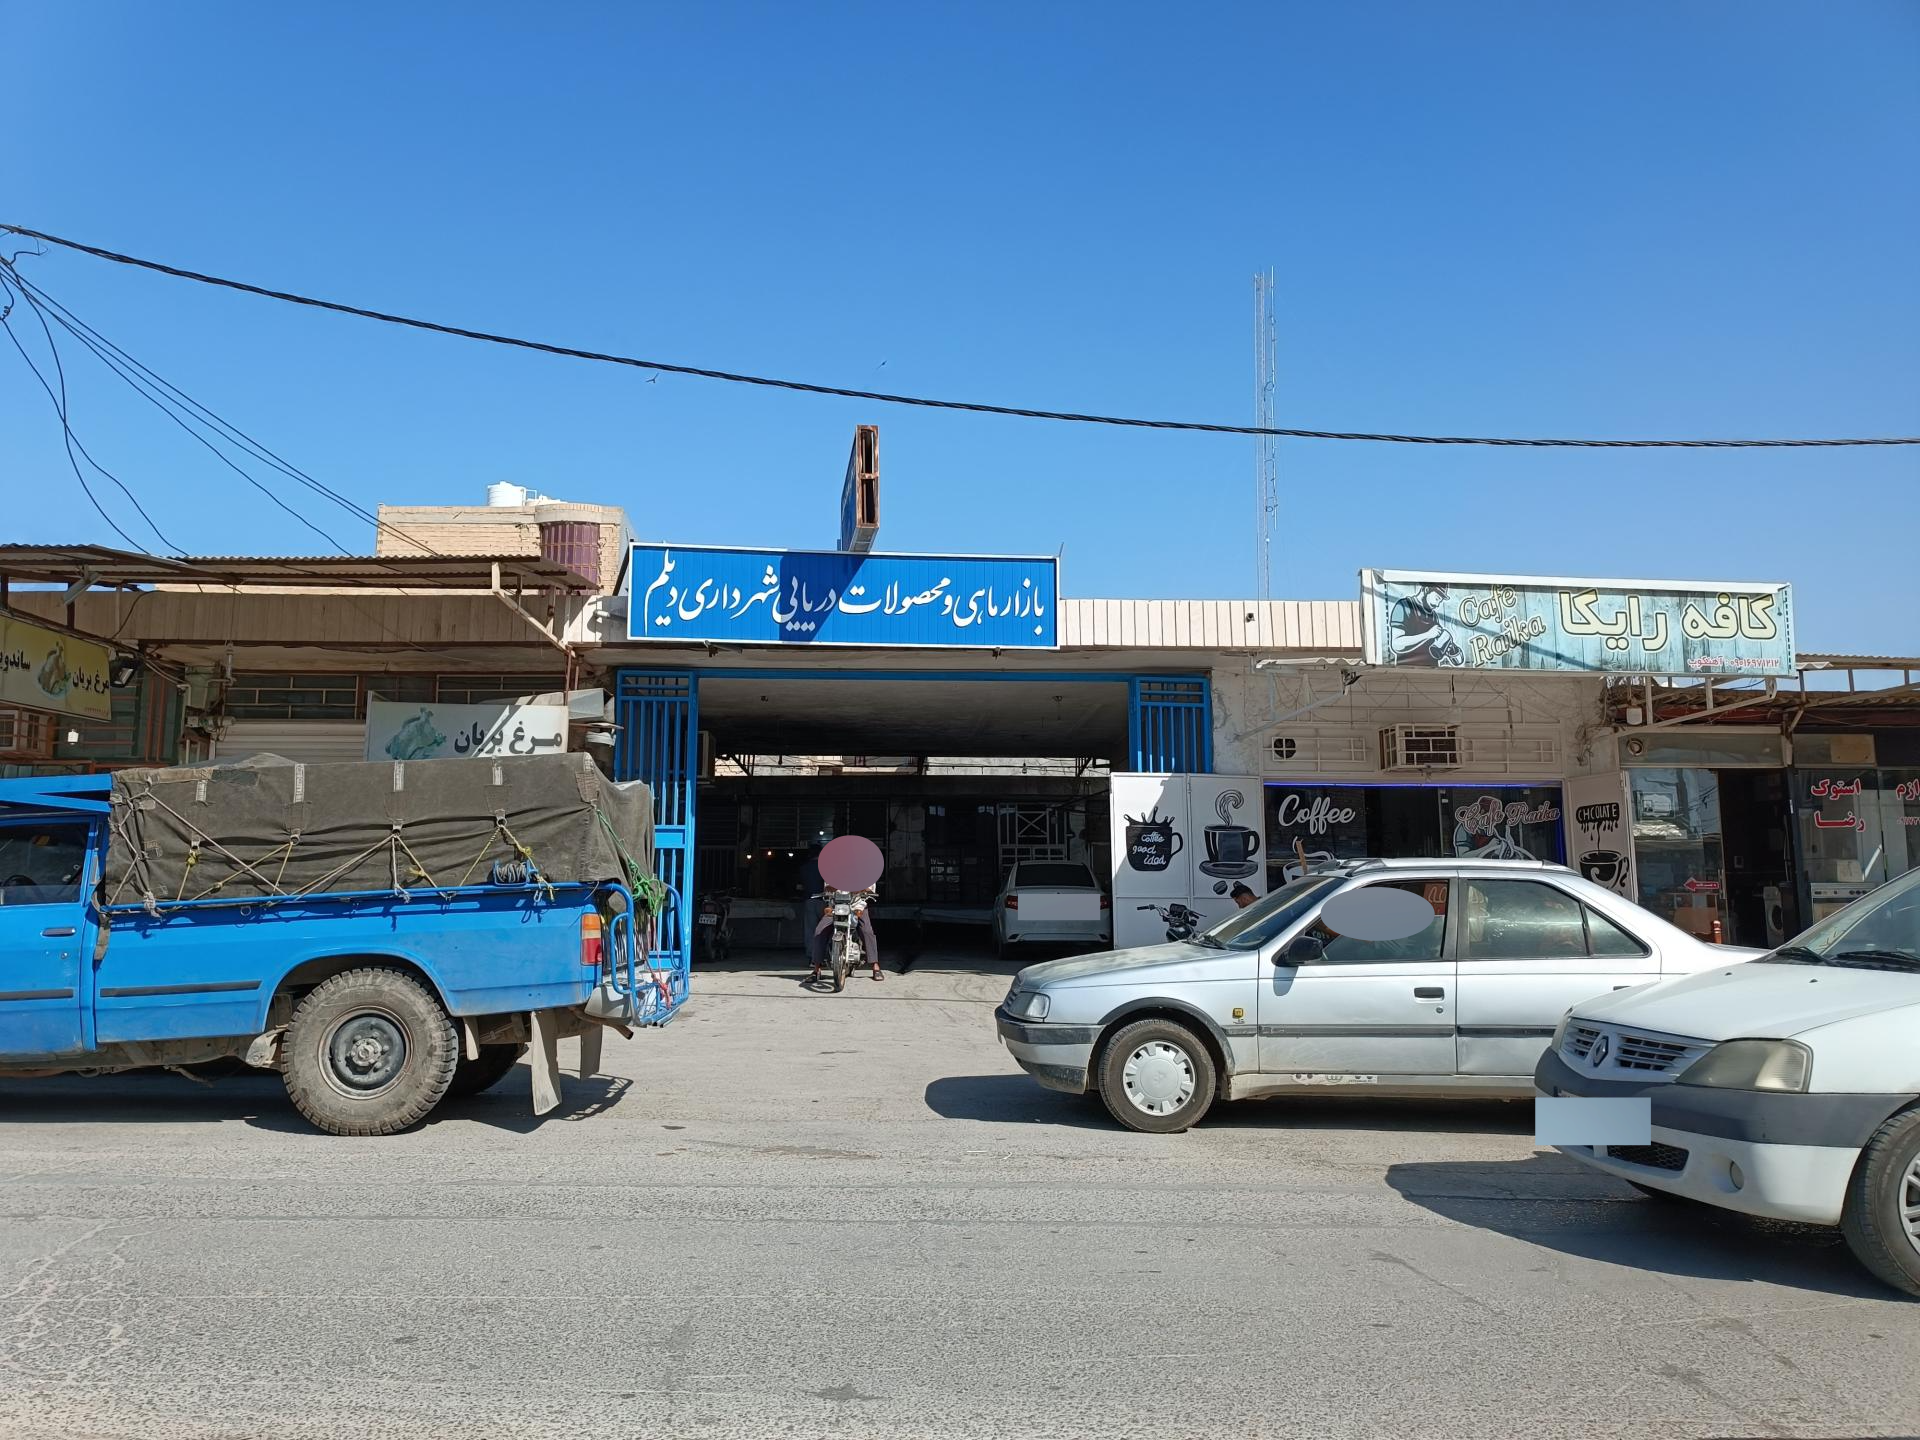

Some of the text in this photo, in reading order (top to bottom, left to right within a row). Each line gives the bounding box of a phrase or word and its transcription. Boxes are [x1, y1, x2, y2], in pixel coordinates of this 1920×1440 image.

[644, 548, 1045, 637] بازار ماهی و محصولات دریایی شهرداری دیلم
[1459, 584, 1517, 628] Cafe
[1558, 588, 1777, 651] کافه رایکا
[1469, 615, 1547, 668] Raika
[72, 666, 110, 695] مرغ بریان
[454, 720, 563, 755] مرغ بریان
[1810, 778, 1862, 801] استوک
[1278, 794, 1356, 835] Coffee
[1505, 800, 1561, 827] Raika
[1813, 810, 1866, 833] رضا
